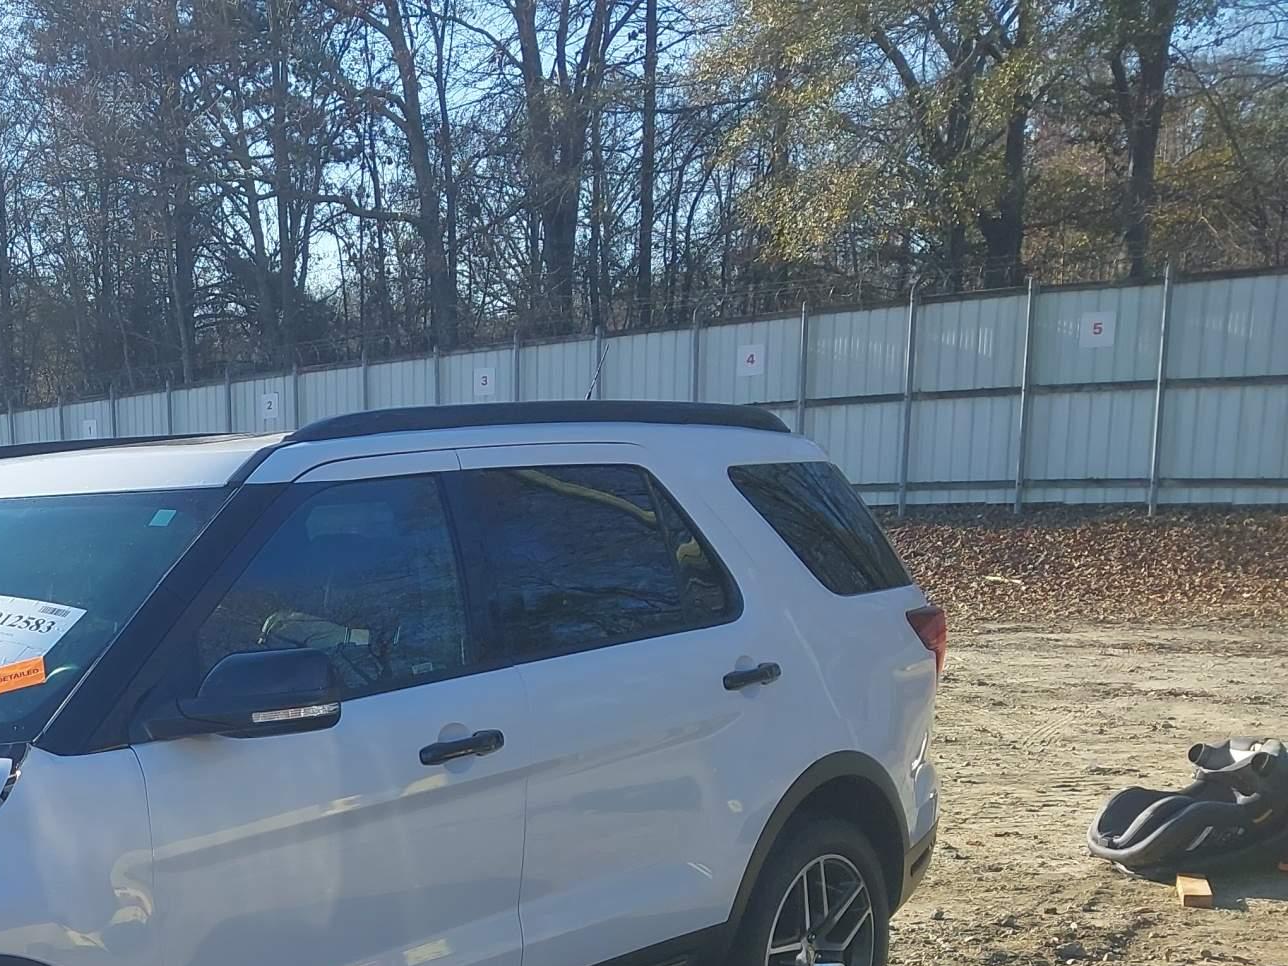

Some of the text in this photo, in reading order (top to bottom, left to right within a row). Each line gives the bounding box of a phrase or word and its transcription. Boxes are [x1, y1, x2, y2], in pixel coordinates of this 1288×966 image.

[1092, 322, 1103, 335] 5
[746, 353, 755, 364] 4
[480, 375, 488, 386] 3
[266, 400, 273, 410] 2
